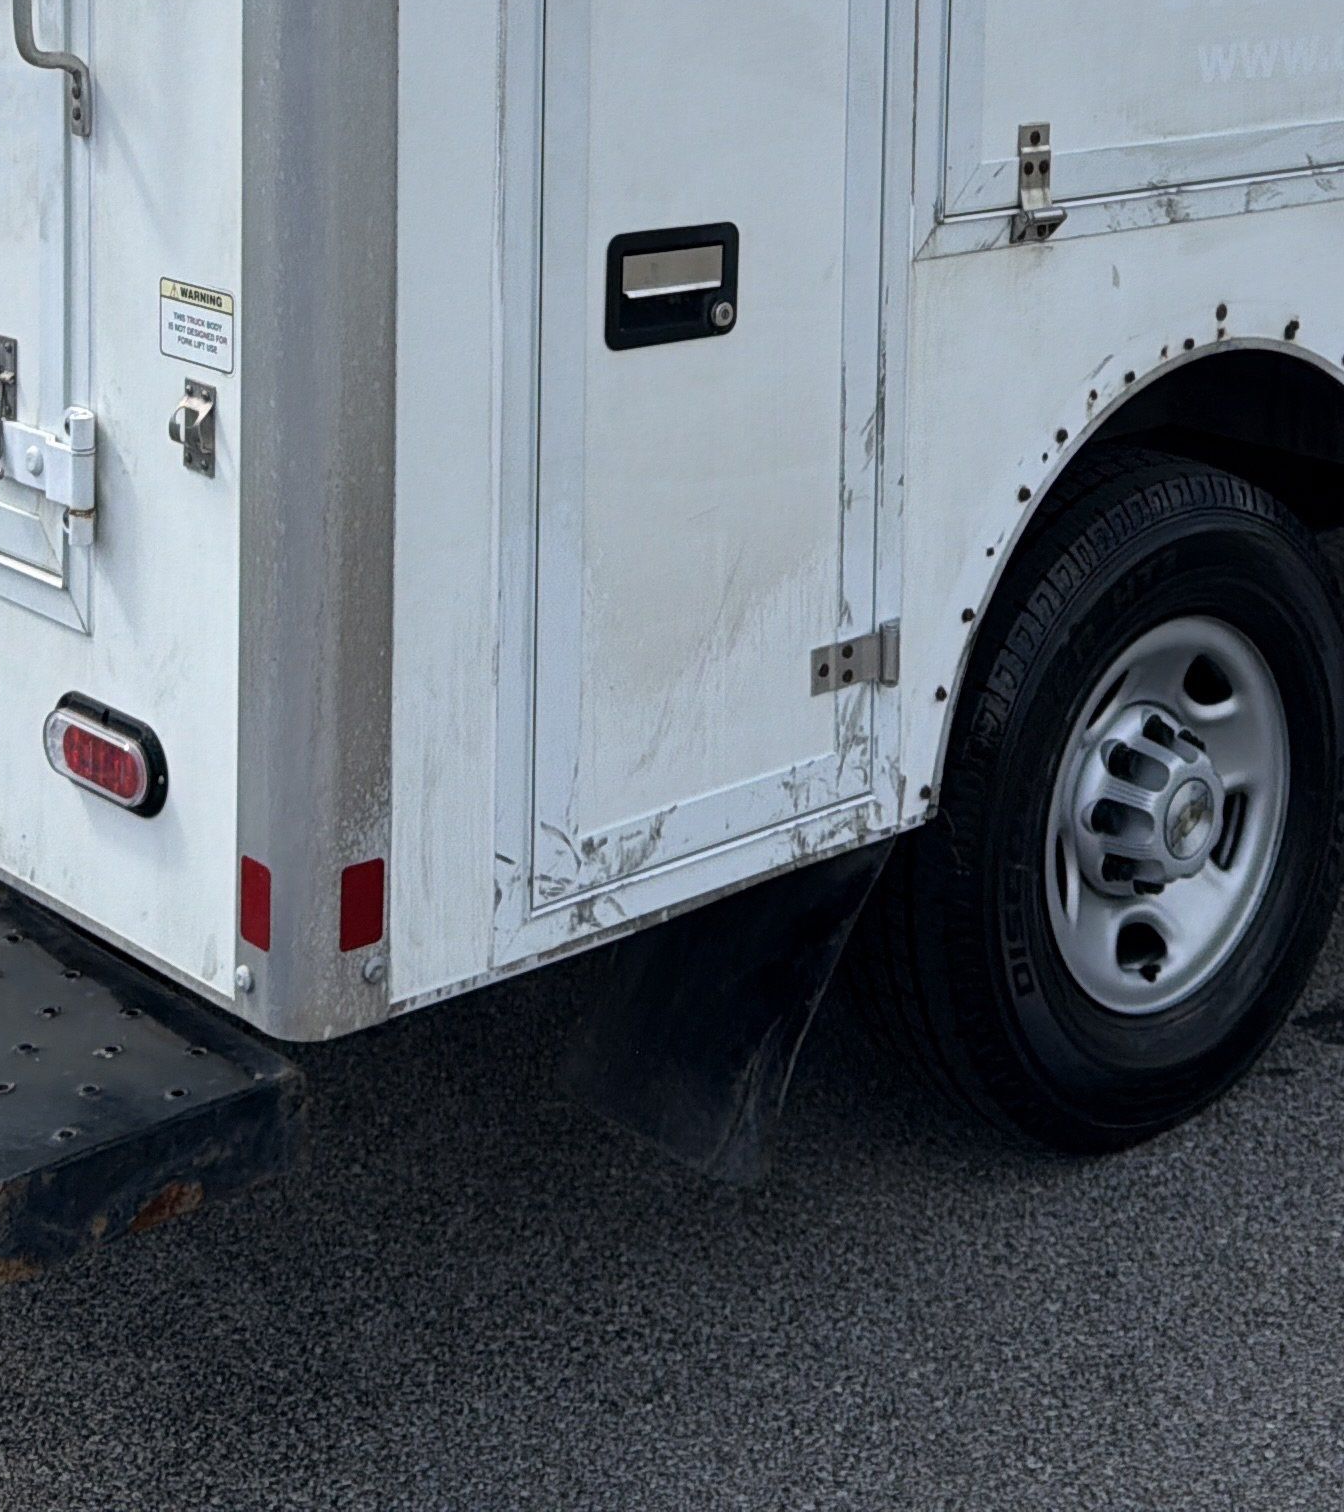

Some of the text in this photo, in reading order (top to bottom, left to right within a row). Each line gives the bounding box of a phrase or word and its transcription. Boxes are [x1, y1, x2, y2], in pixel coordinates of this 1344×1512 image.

[180, 286, 223, 308] WARNING
[173, 311, 222, 332] THIS TRUCK BODY
[168, 322, 228, 345] IS NOT DESIGNED FOR
[177, 335, 193, 347] FORK
[193, 340, 205, 351] LIFT
